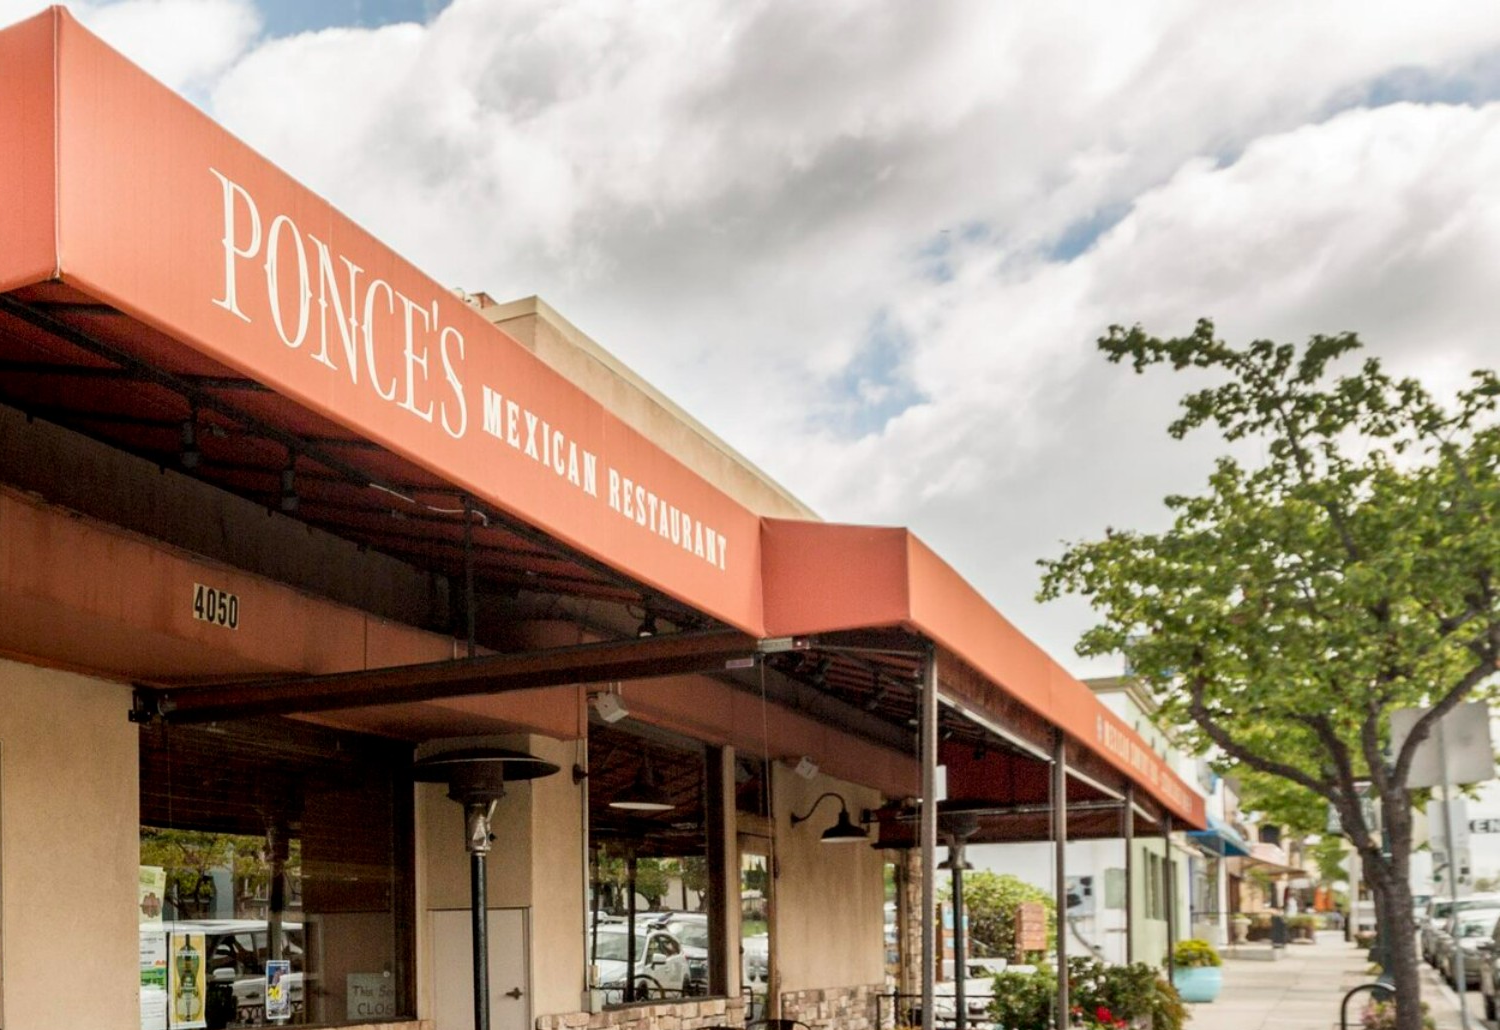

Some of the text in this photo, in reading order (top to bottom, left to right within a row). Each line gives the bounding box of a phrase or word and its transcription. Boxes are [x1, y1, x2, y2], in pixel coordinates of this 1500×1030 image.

[209, 166, 728, 571] PONCE'S MEXICAN RESTAURANT
[195, 585, 238, 629] 4050
[357, 1001, 395, 1016] CLOS
